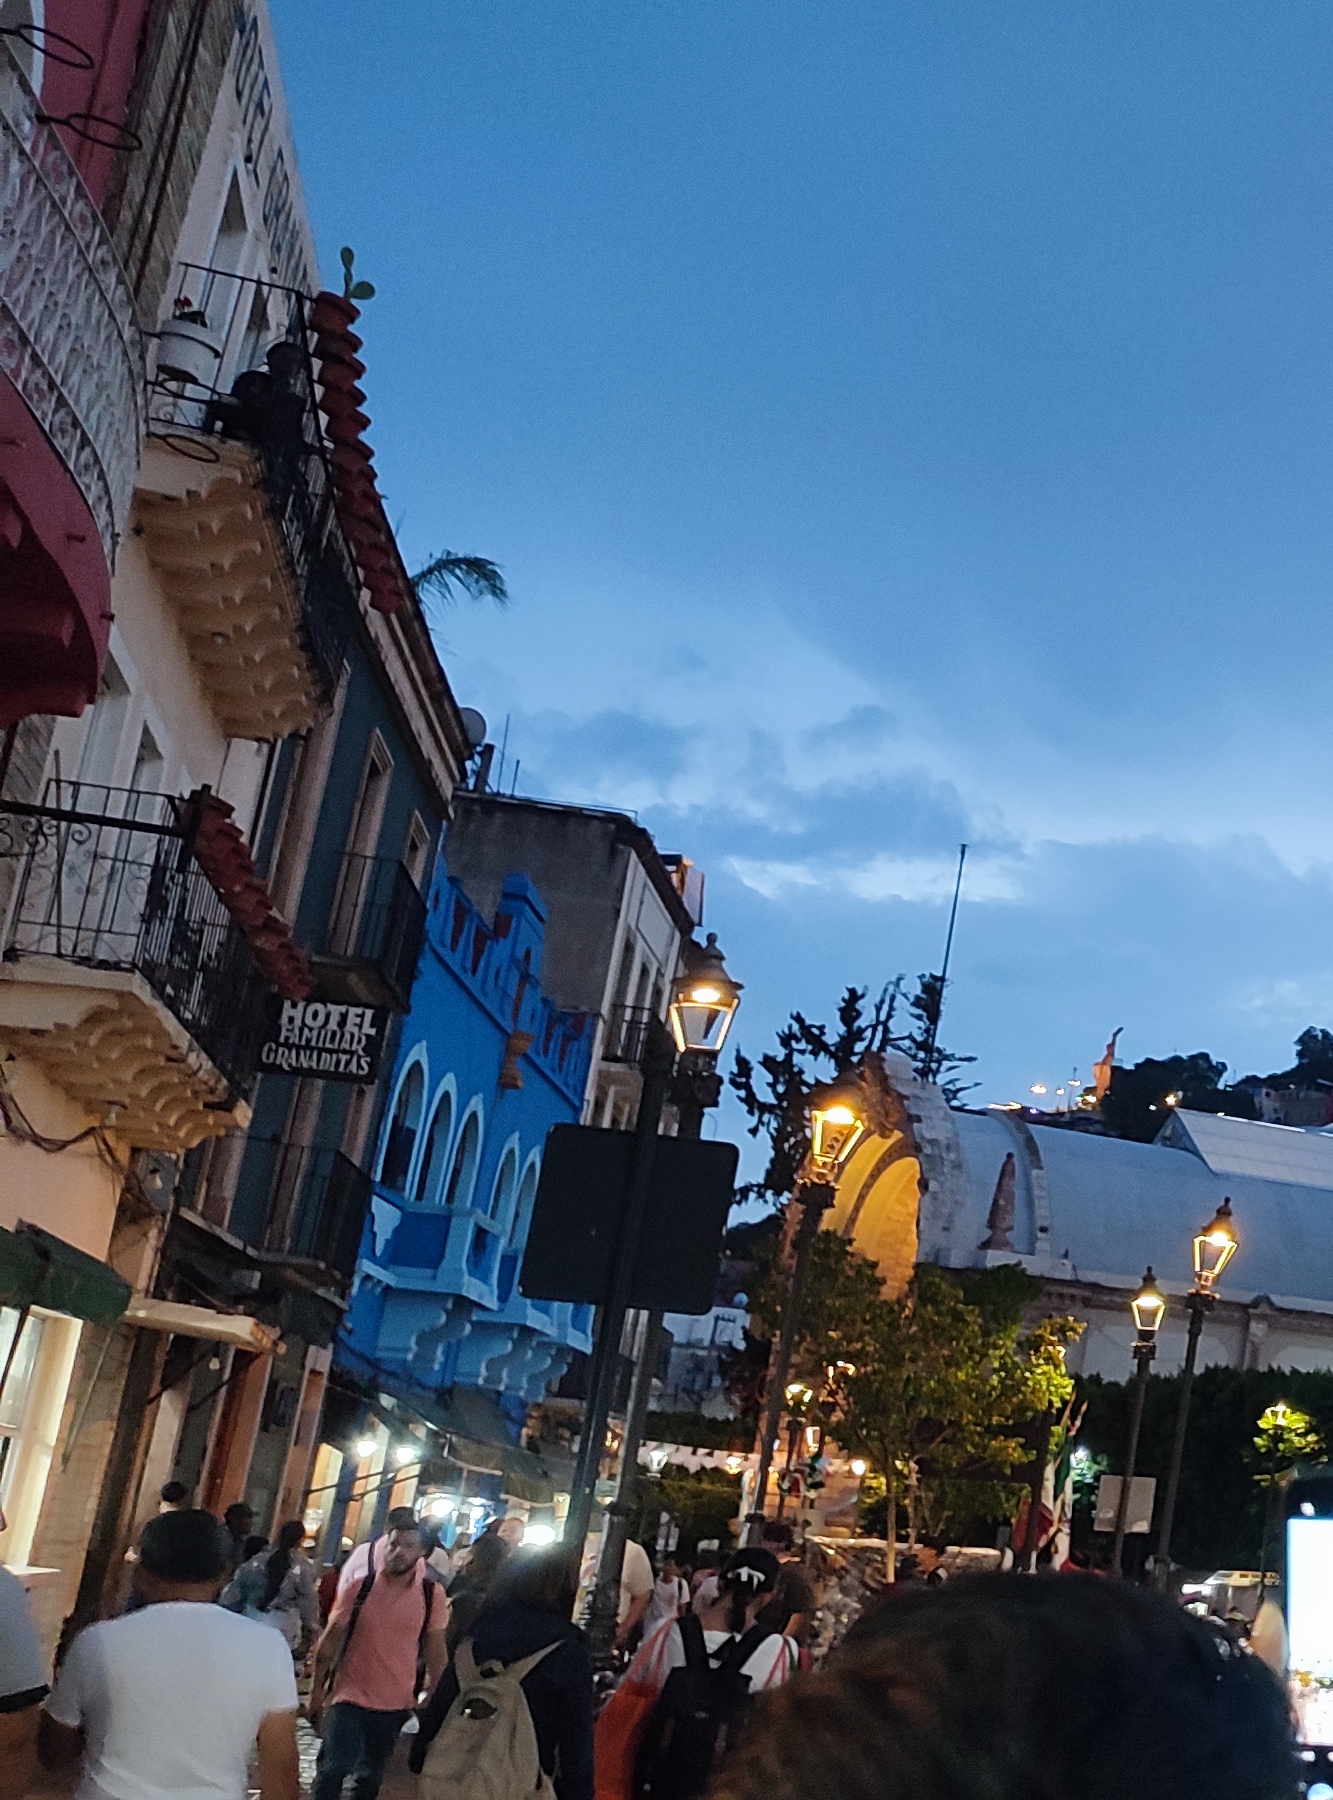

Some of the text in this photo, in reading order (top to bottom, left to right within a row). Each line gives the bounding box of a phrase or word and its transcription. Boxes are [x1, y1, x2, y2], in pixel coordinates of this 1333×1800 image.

[279, 999, 377, 1036] HOTEL
[278, 1024, 367, 1056] FAMILIAR
[261, 1042, 372, 1075] GRANADITAS
